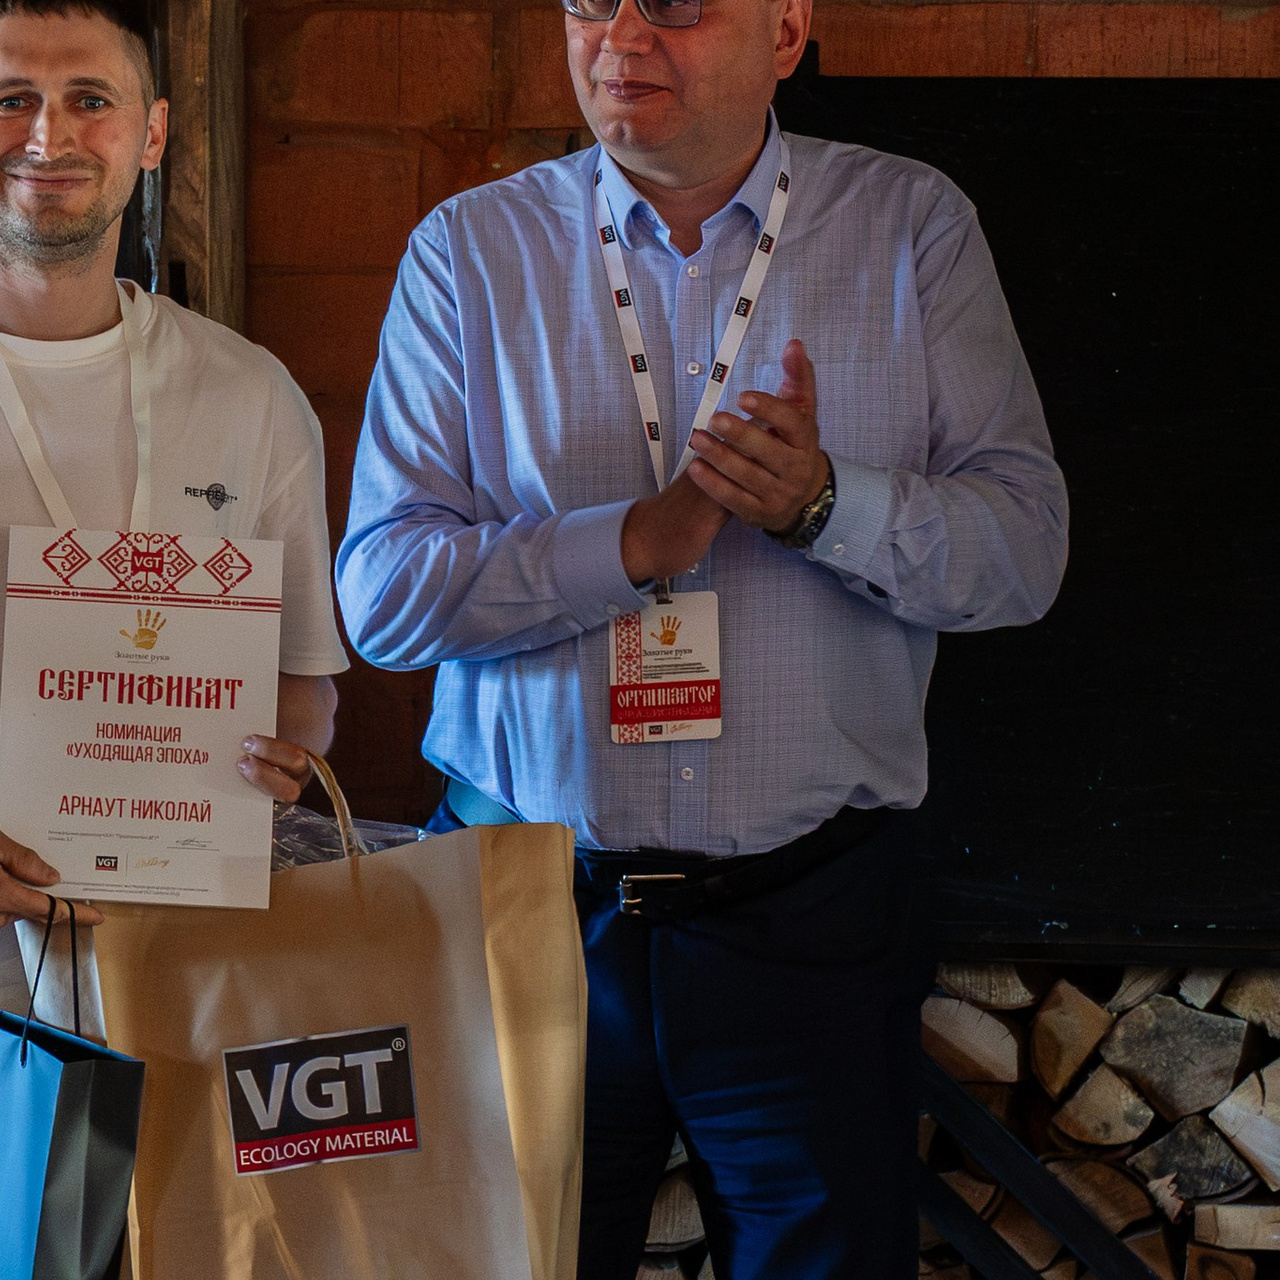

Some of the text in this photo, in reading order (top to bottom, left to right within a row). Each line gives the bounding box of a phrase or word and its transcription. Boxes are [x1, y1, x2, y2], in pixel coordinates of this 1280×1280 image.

[760, 234, 771, 251] VGT
[619, 288, 630, 305] VGT
[736, 298, 748, 315] VGT
[634, 354, 646, 371] VGT
[712, 363, 724, 381] VGT
[133, 555, 162, 569] VGT
[38, 668, 243, 710] СЕРТИФИКАТ
[617, 684, 716, 708] ОРГАНИЗАТОР
[95, 722, 182, 743] НОМИНАЦИЯ
[66, 742, 210, 765] «УХОДЯЩАЯ ЭПОХА»
[58, 795, 212, 823] АРНАУТ НИКОЛАЙ
[97, 857, 117, 868] VGT
[239, 1127, 413, 1166] ECOLOGY MATERIAL
